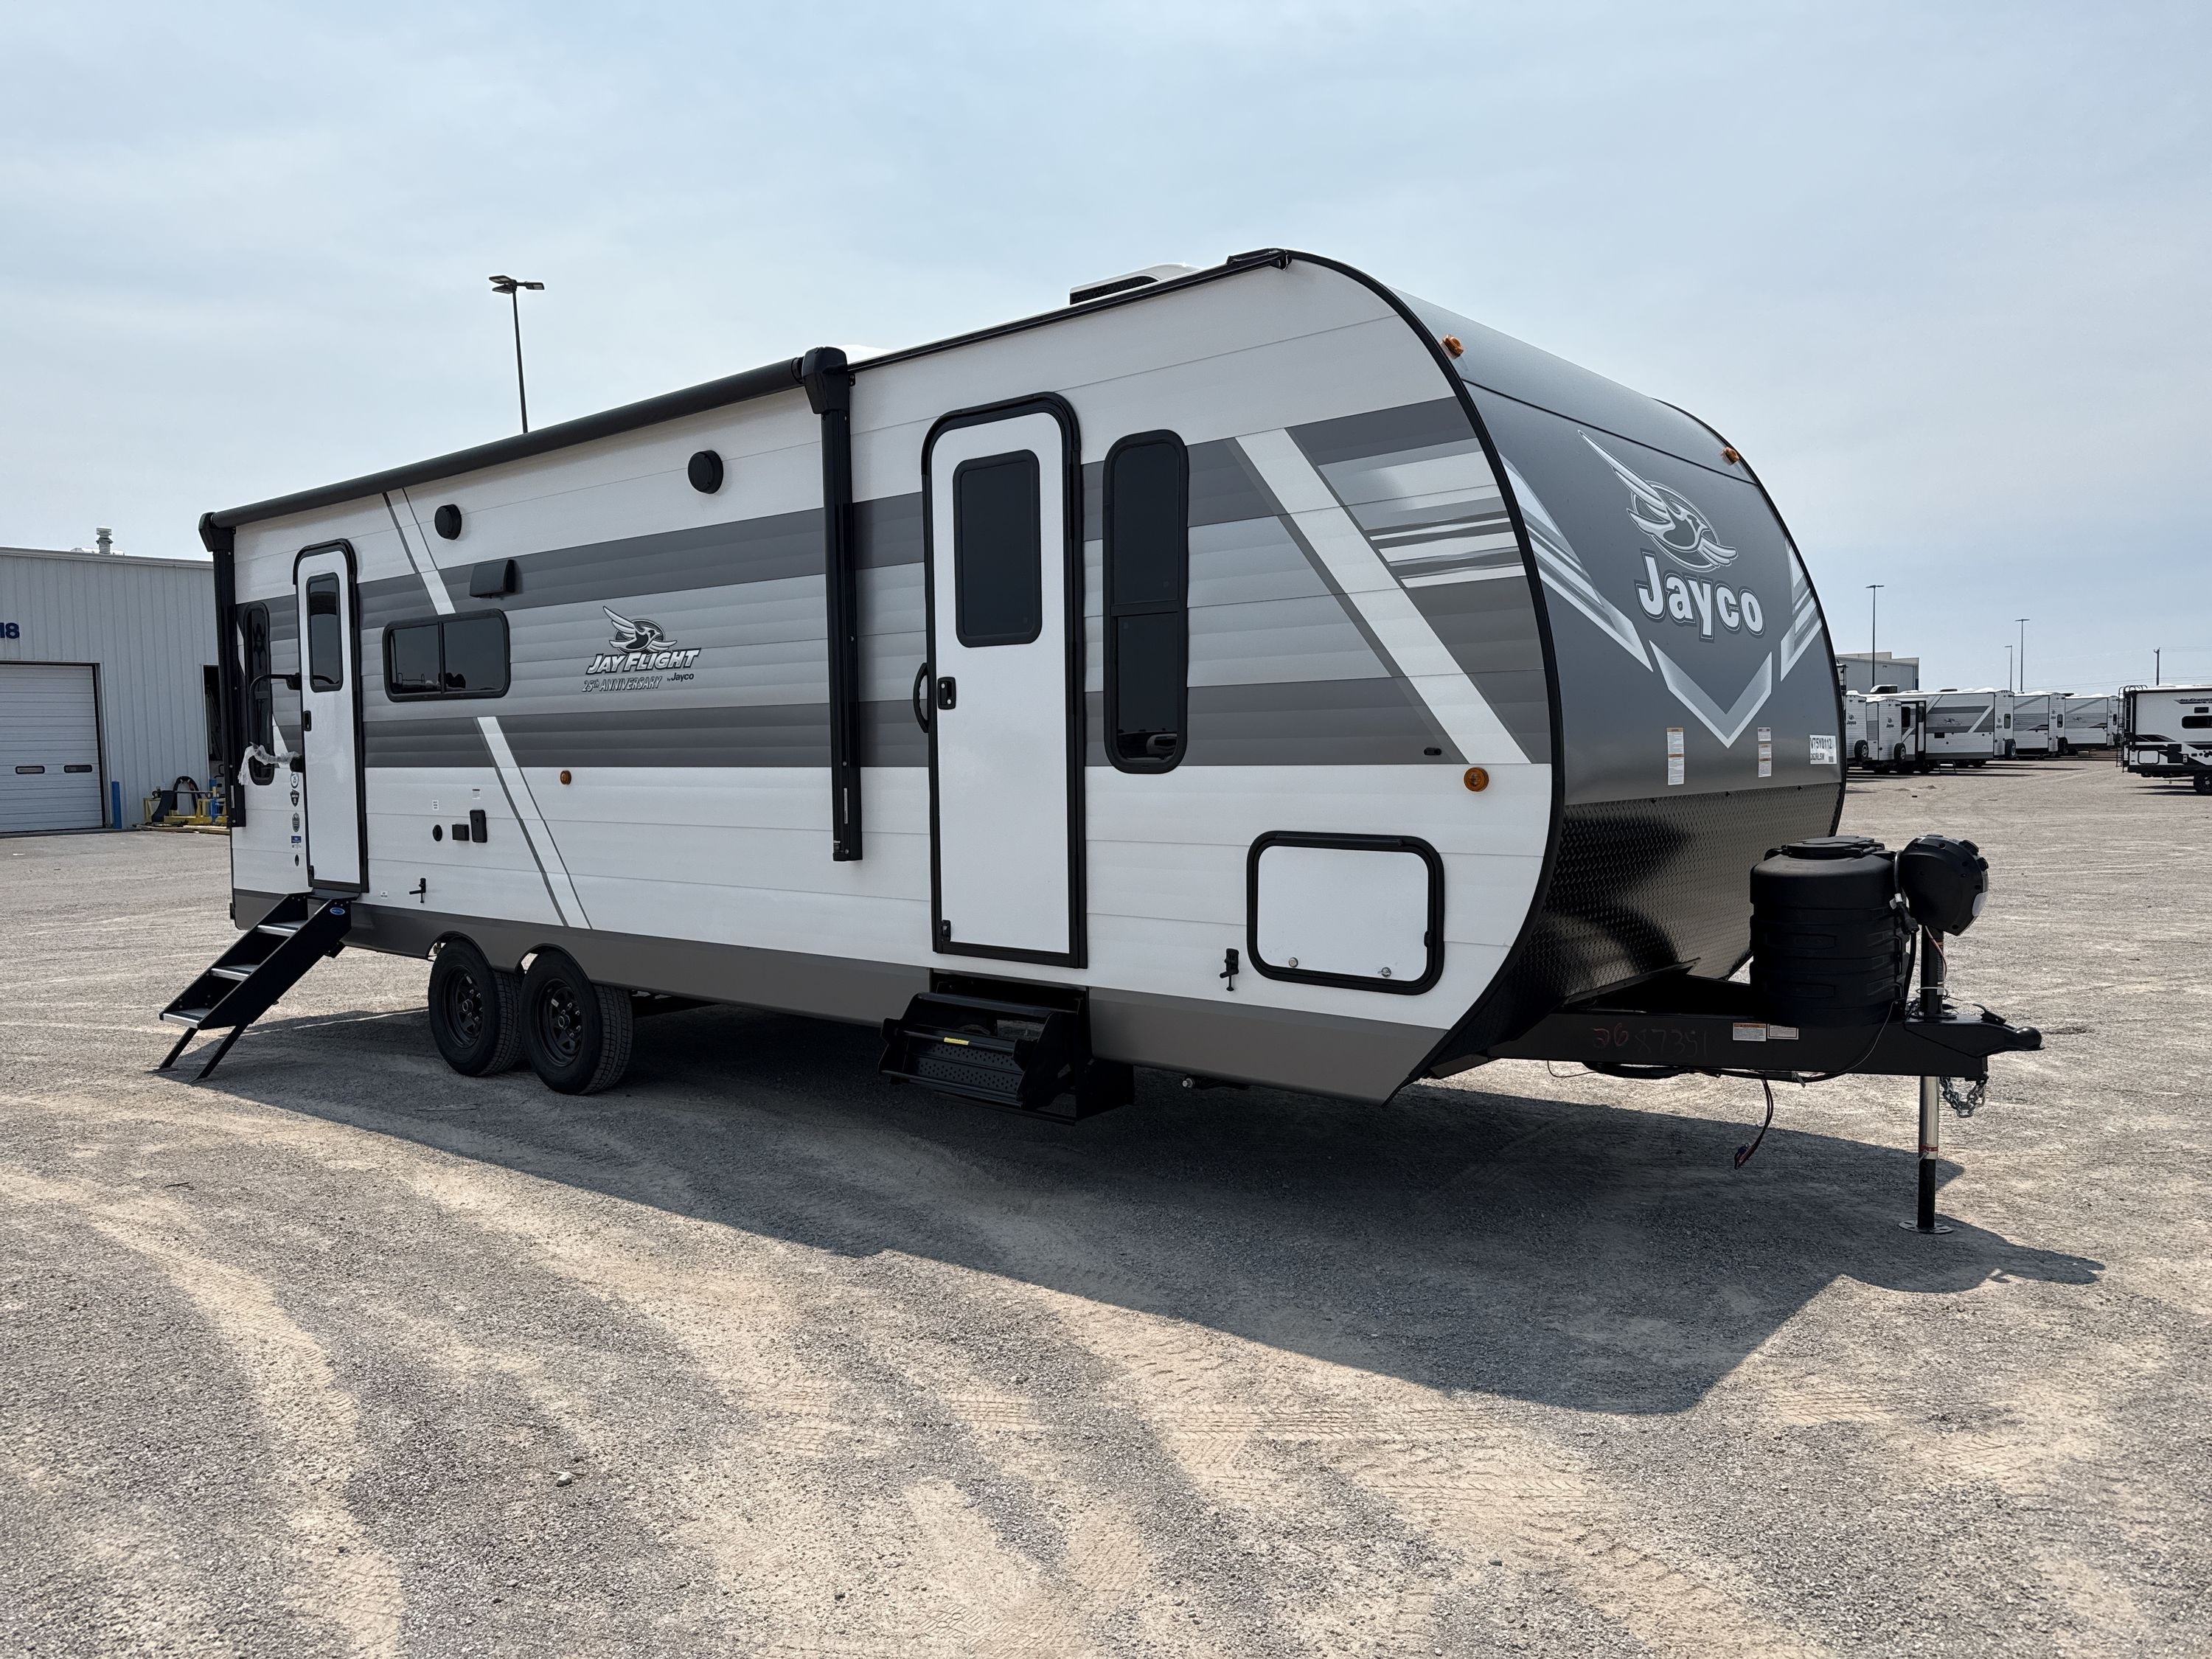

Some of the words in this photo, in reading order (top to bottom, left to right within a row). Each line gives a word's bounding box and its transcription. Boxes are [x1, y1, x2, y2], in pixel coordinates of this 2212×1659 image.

[1635, 549, 1765, 642] Jayco
[585, 653, 626, 675] JAY
[622, 648, 701, 672] FLIGHT
[599, 675, 663, 692] ANNIVERSARY
[672, 672, 695, 683] Jayco
